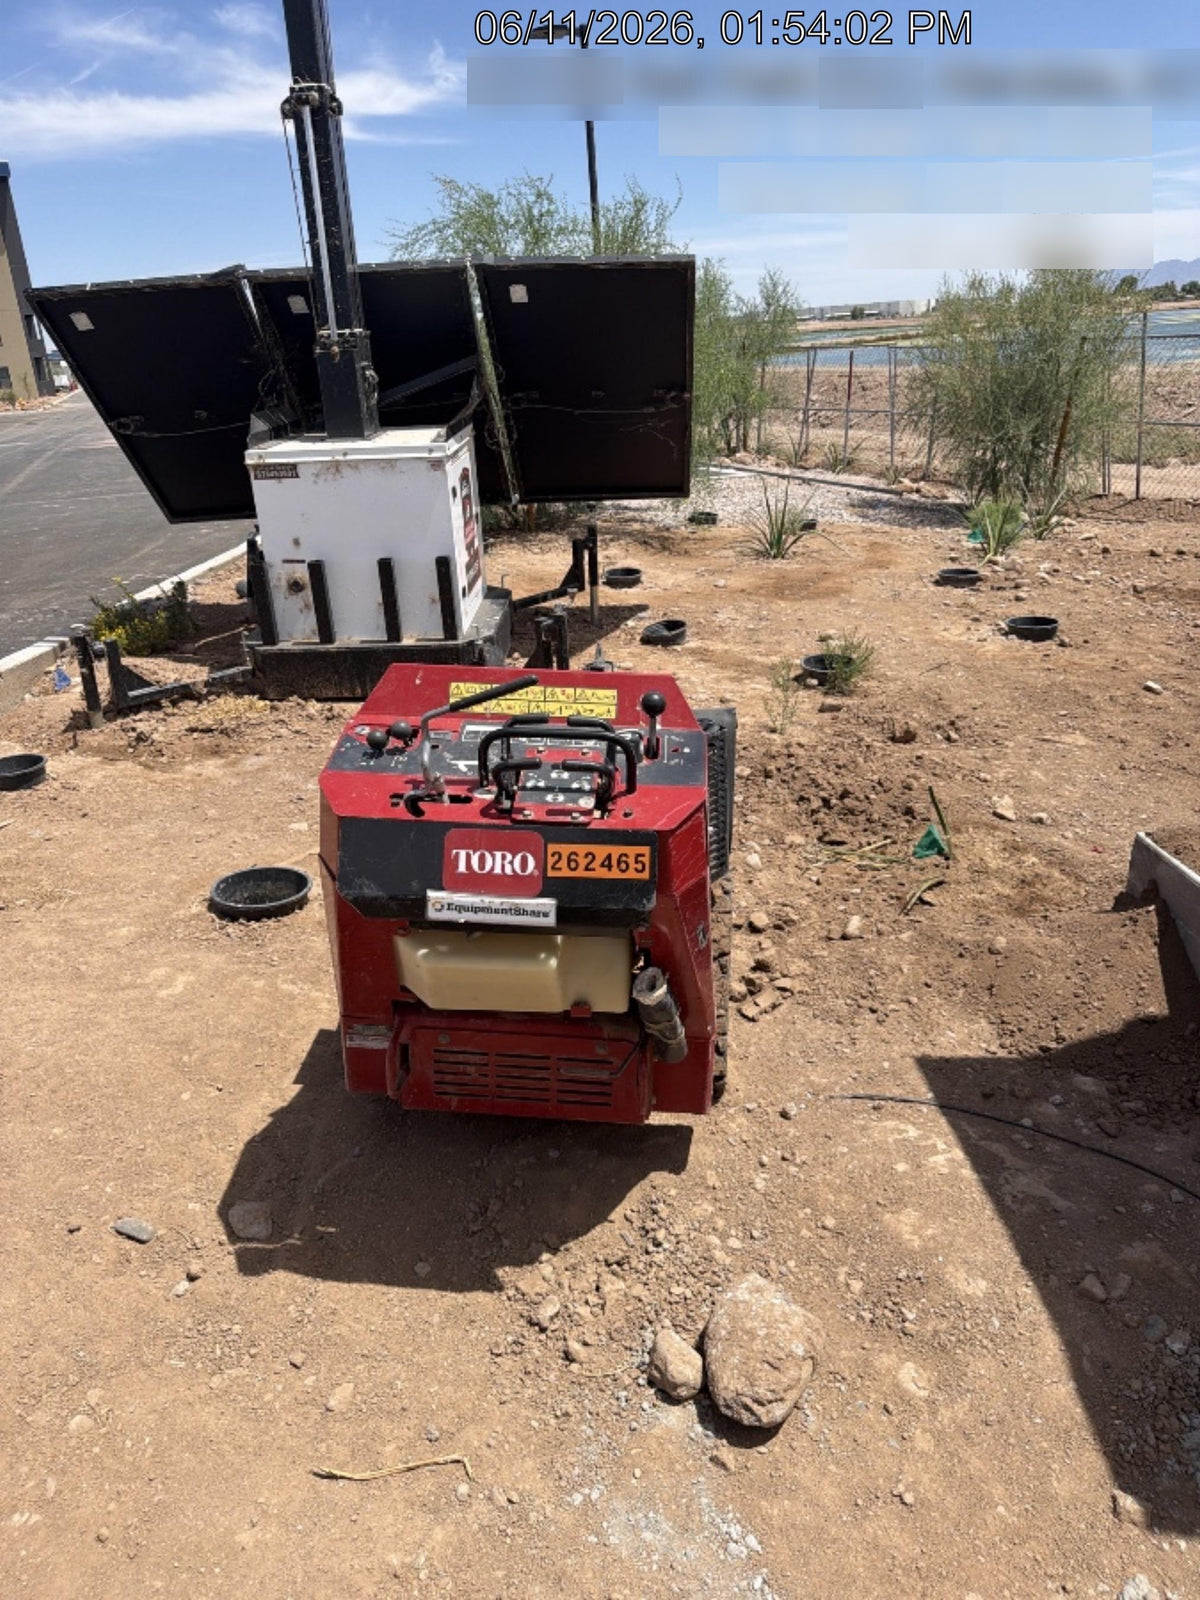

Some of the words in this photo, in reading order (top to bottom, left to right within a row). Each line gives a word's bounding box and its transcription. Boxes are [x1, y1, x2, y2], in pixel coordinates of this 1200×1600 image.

[451, 849, 536, 875] TORO
[550, 851, 647, 874] 262465
[446, 902, 551, 918] EquipmentShare
